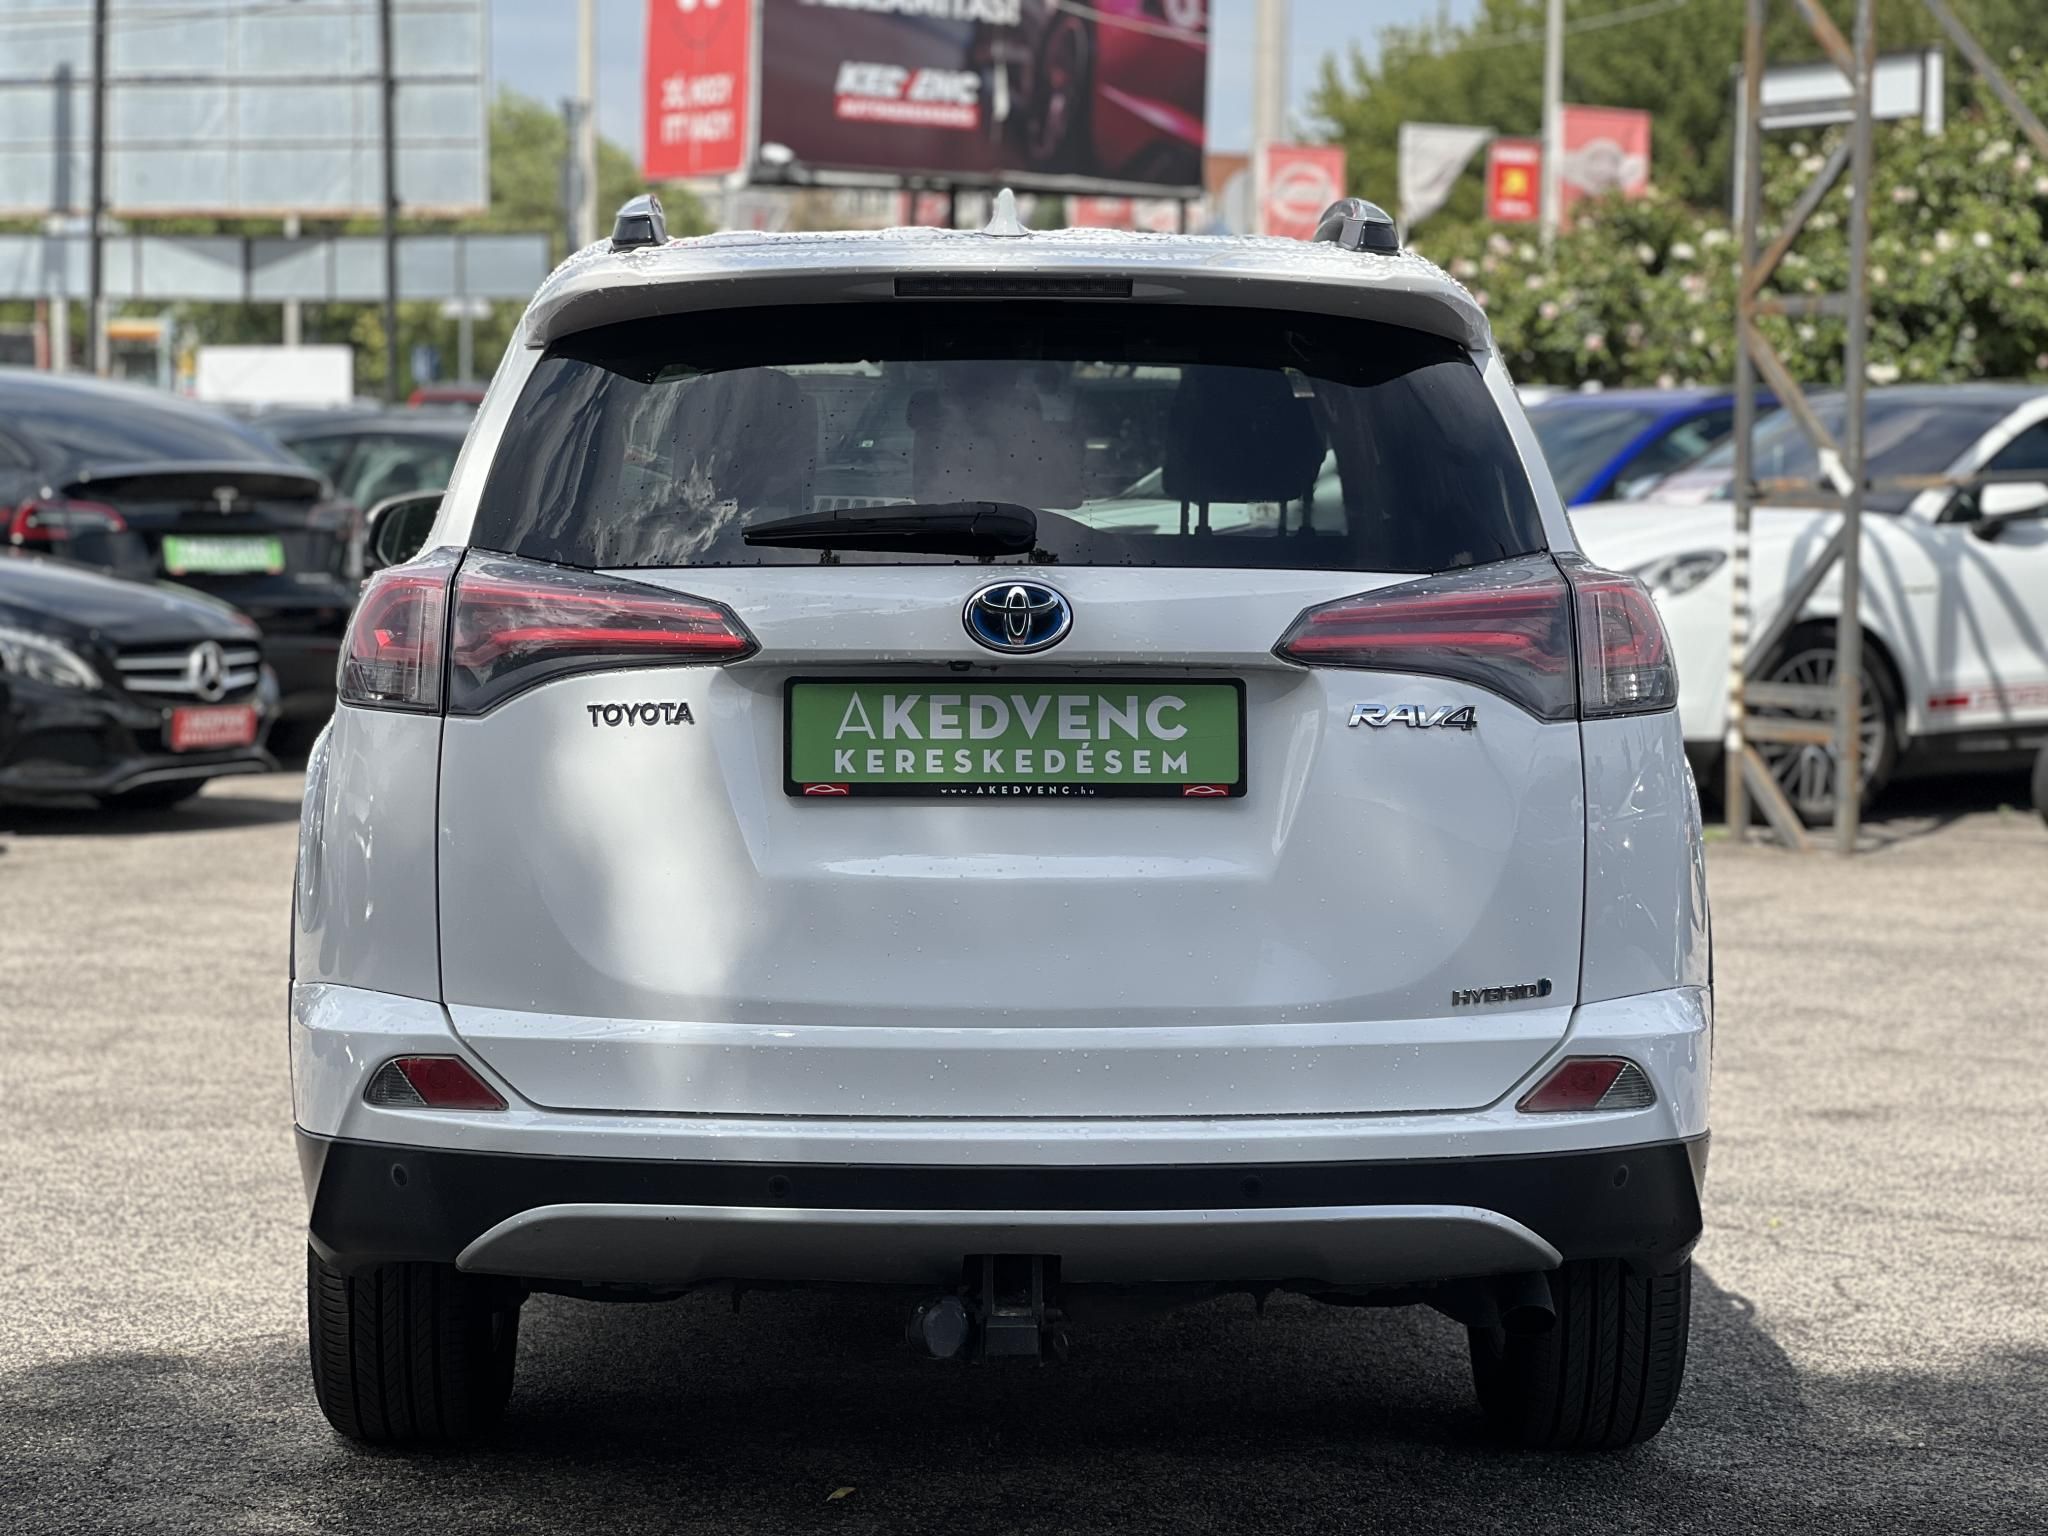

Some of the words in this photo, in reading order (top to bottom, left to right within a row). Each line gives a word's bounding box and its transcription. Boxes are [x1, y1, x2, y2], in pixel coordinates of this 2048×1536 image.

[586, 702, 695, 727] TOYOTA
[835, 691, 1188, 741] AKEDVENC
[1348, 703, 1477, 730] RAV4
[834, 742, 1188, 774] KERESKEDÉSEM
[940, 785, 1095, 795] www.AKEDVENC.hu
[1452, 983, 1537, 1006] HYBRID
